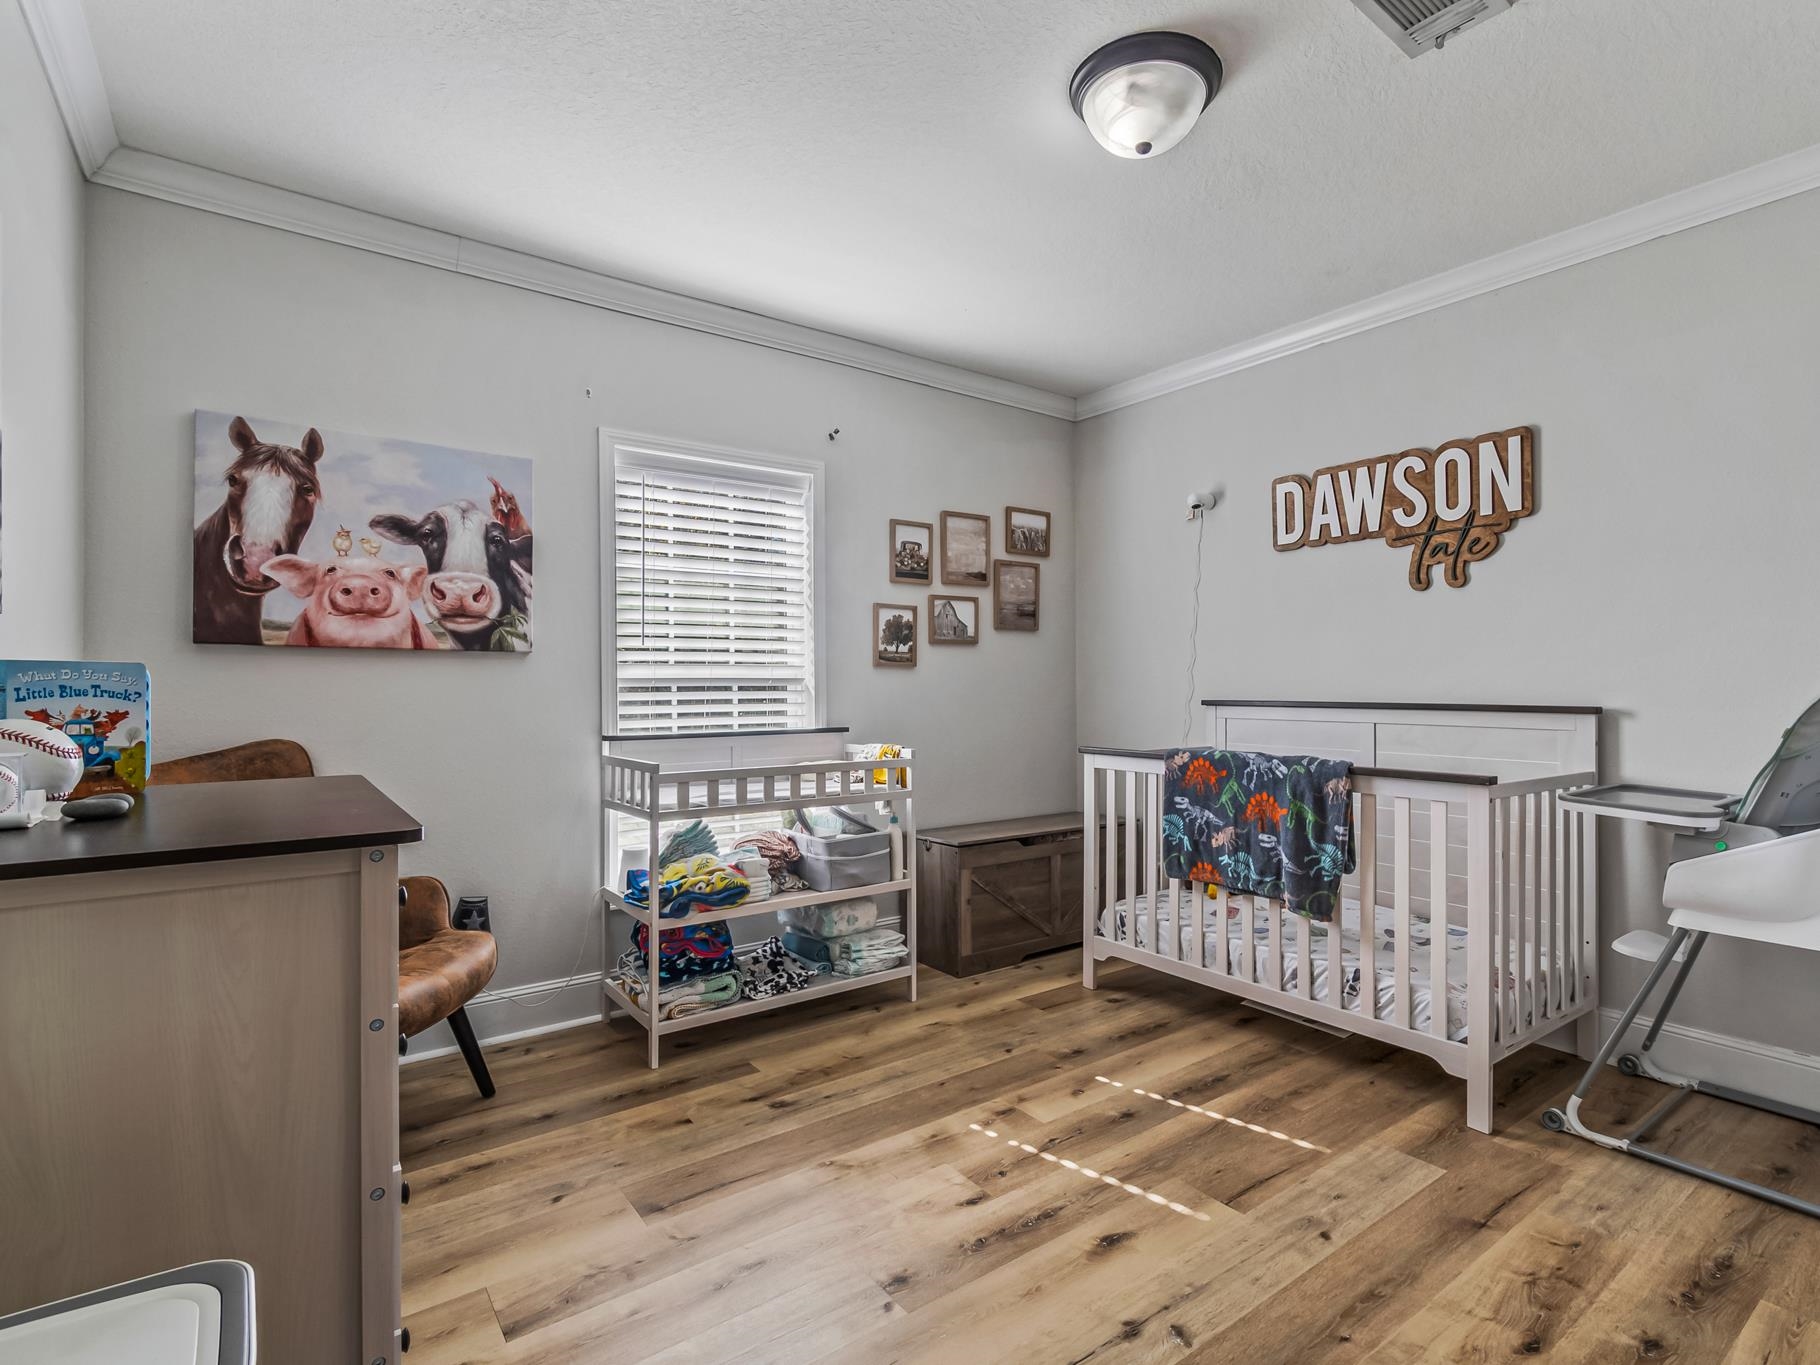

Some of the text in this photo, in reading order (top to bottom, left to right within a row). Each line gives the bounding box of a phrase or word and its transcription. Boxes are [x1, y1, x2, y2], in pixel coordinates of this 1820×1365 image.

[1276, 435, 1522, 545] DAWSON
[18, 671, 57, 683] What
[60, 669, 80, 679] Do
[82, 669, 108, 680] You
[13, 684, 142, 702] Little Blue Truck?
